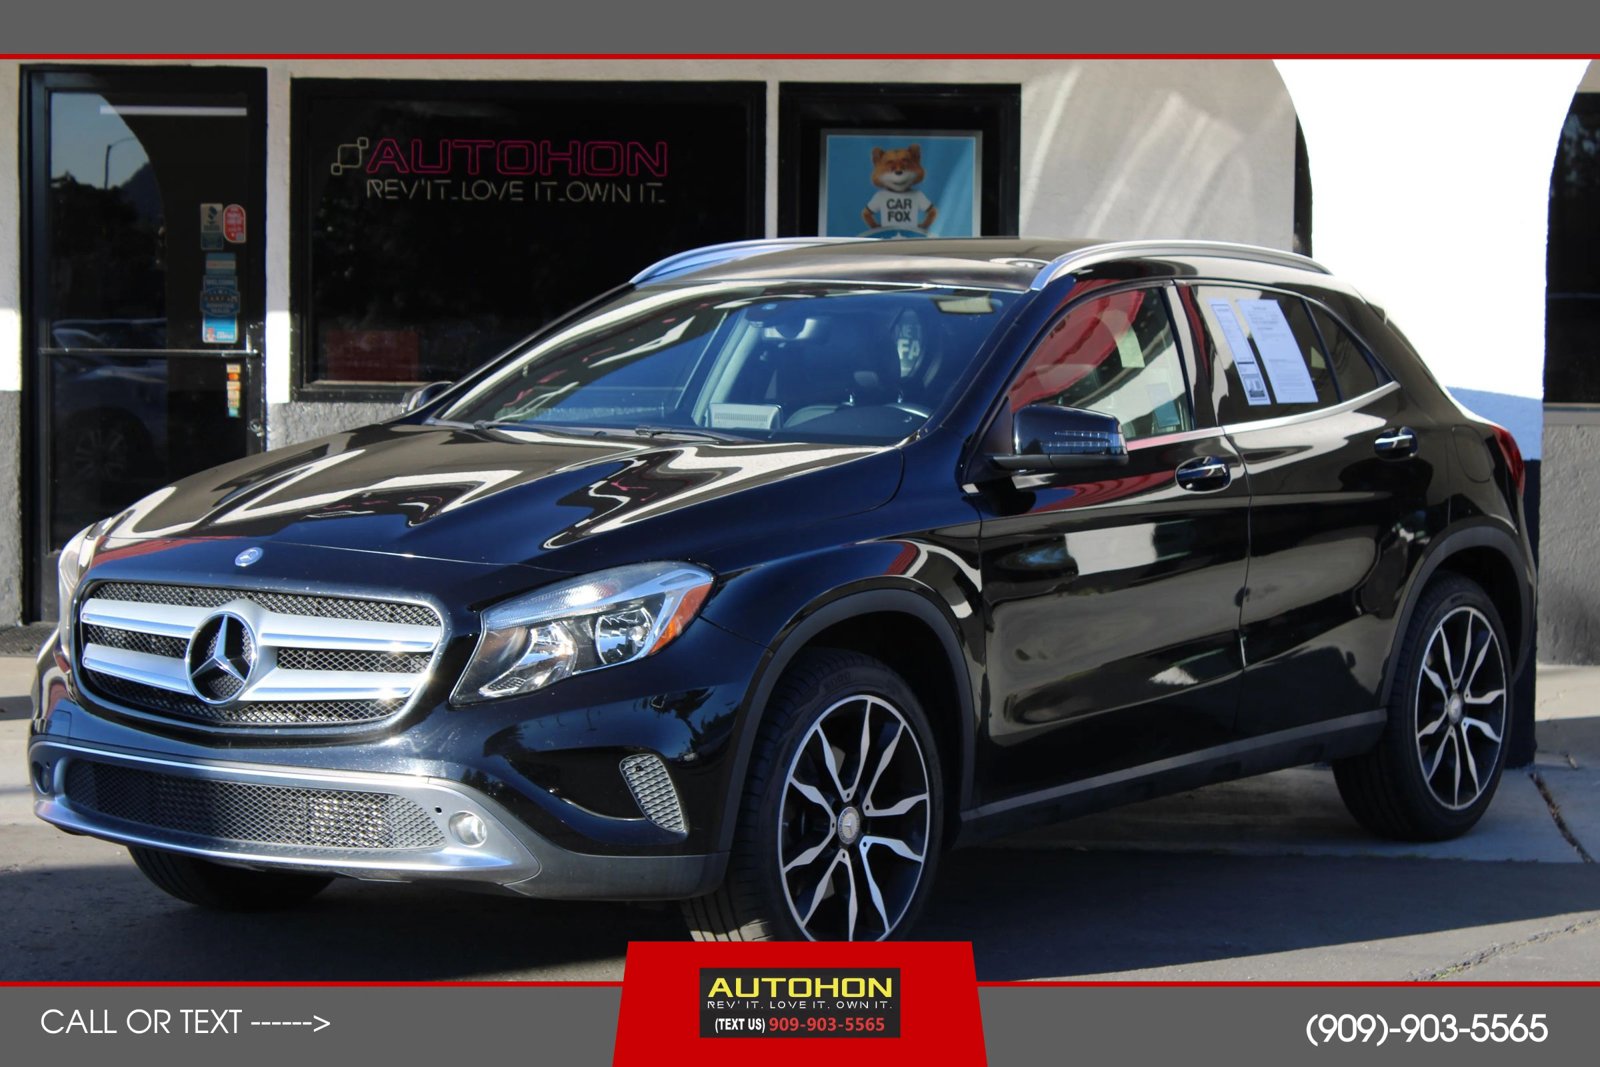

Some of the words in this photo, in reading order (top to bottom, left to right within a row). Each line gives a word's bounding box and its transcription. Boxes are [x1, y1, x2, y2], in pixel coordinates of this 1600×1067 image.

[365, 138, 668, 177] AUTOHON
[886, 198, 912, 210] CAR
[887, 210, 912, 222] FOX
